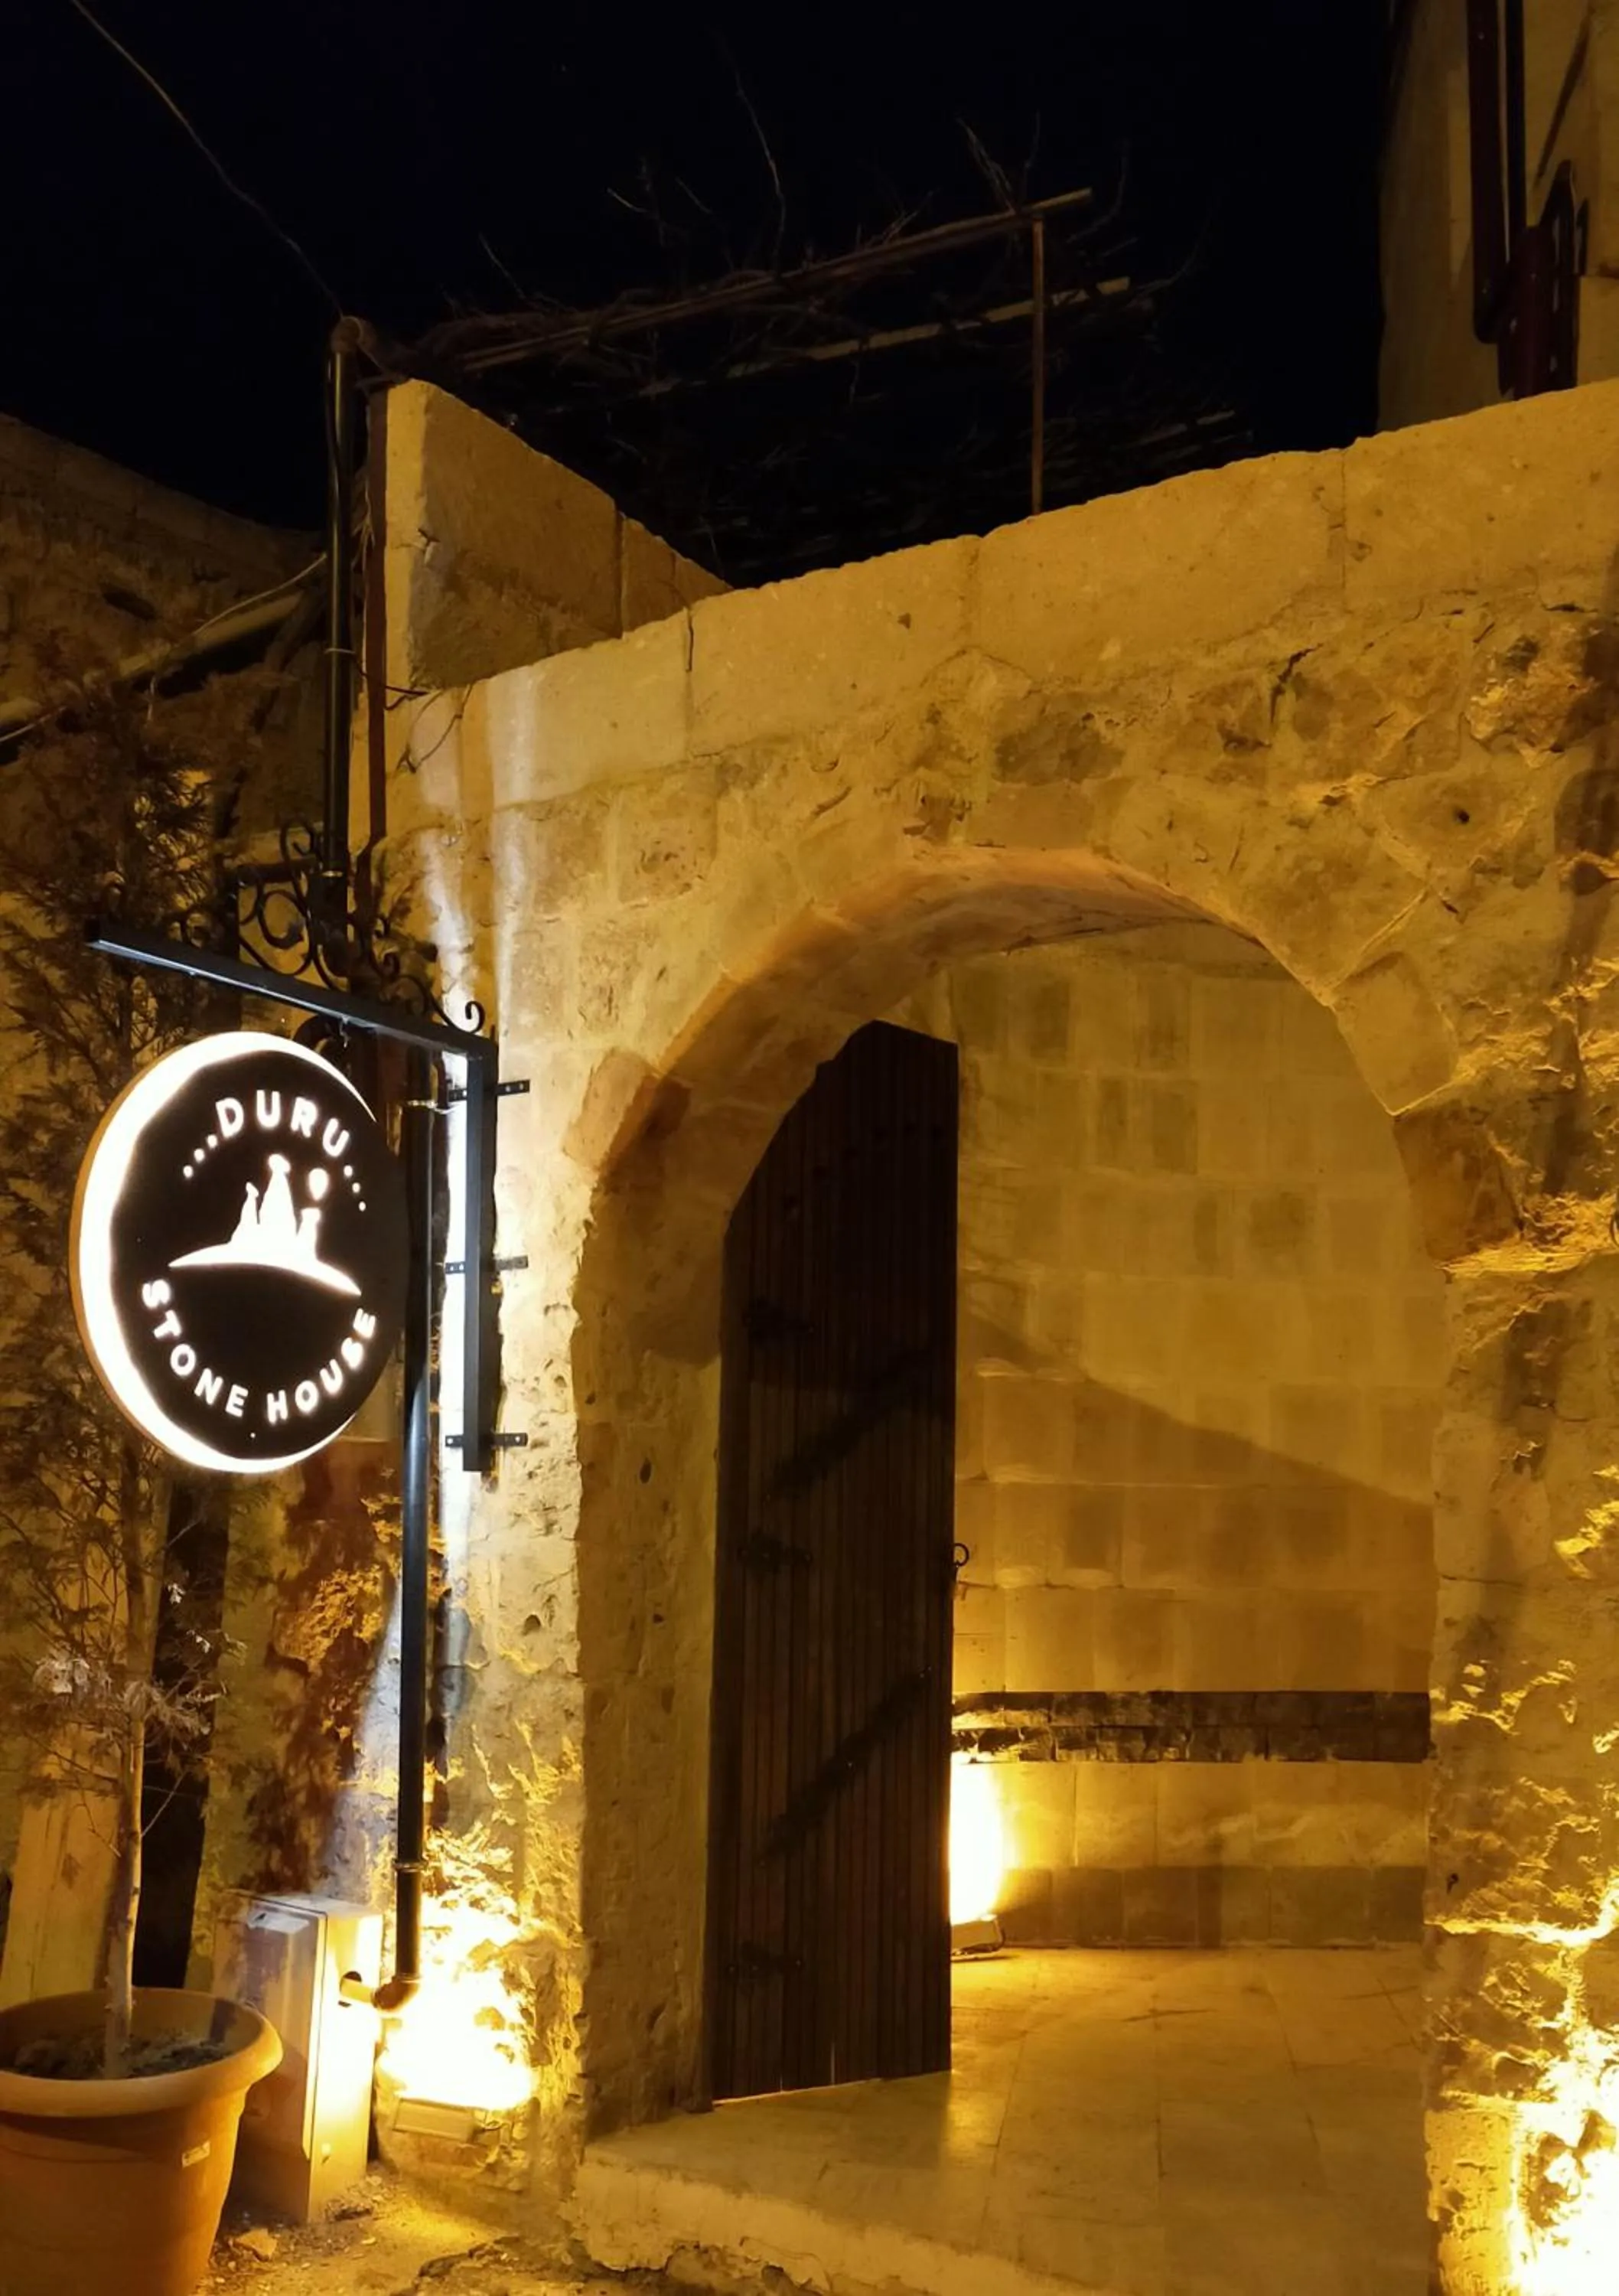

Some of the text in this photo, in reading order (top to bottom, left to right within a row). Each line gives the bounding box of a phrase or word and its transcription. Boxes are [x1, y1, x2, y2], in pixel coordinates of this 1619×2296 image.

[215, 1089, 350, 1158] DURU
[141, 1278, 377, 1425] STONE HOUSE
